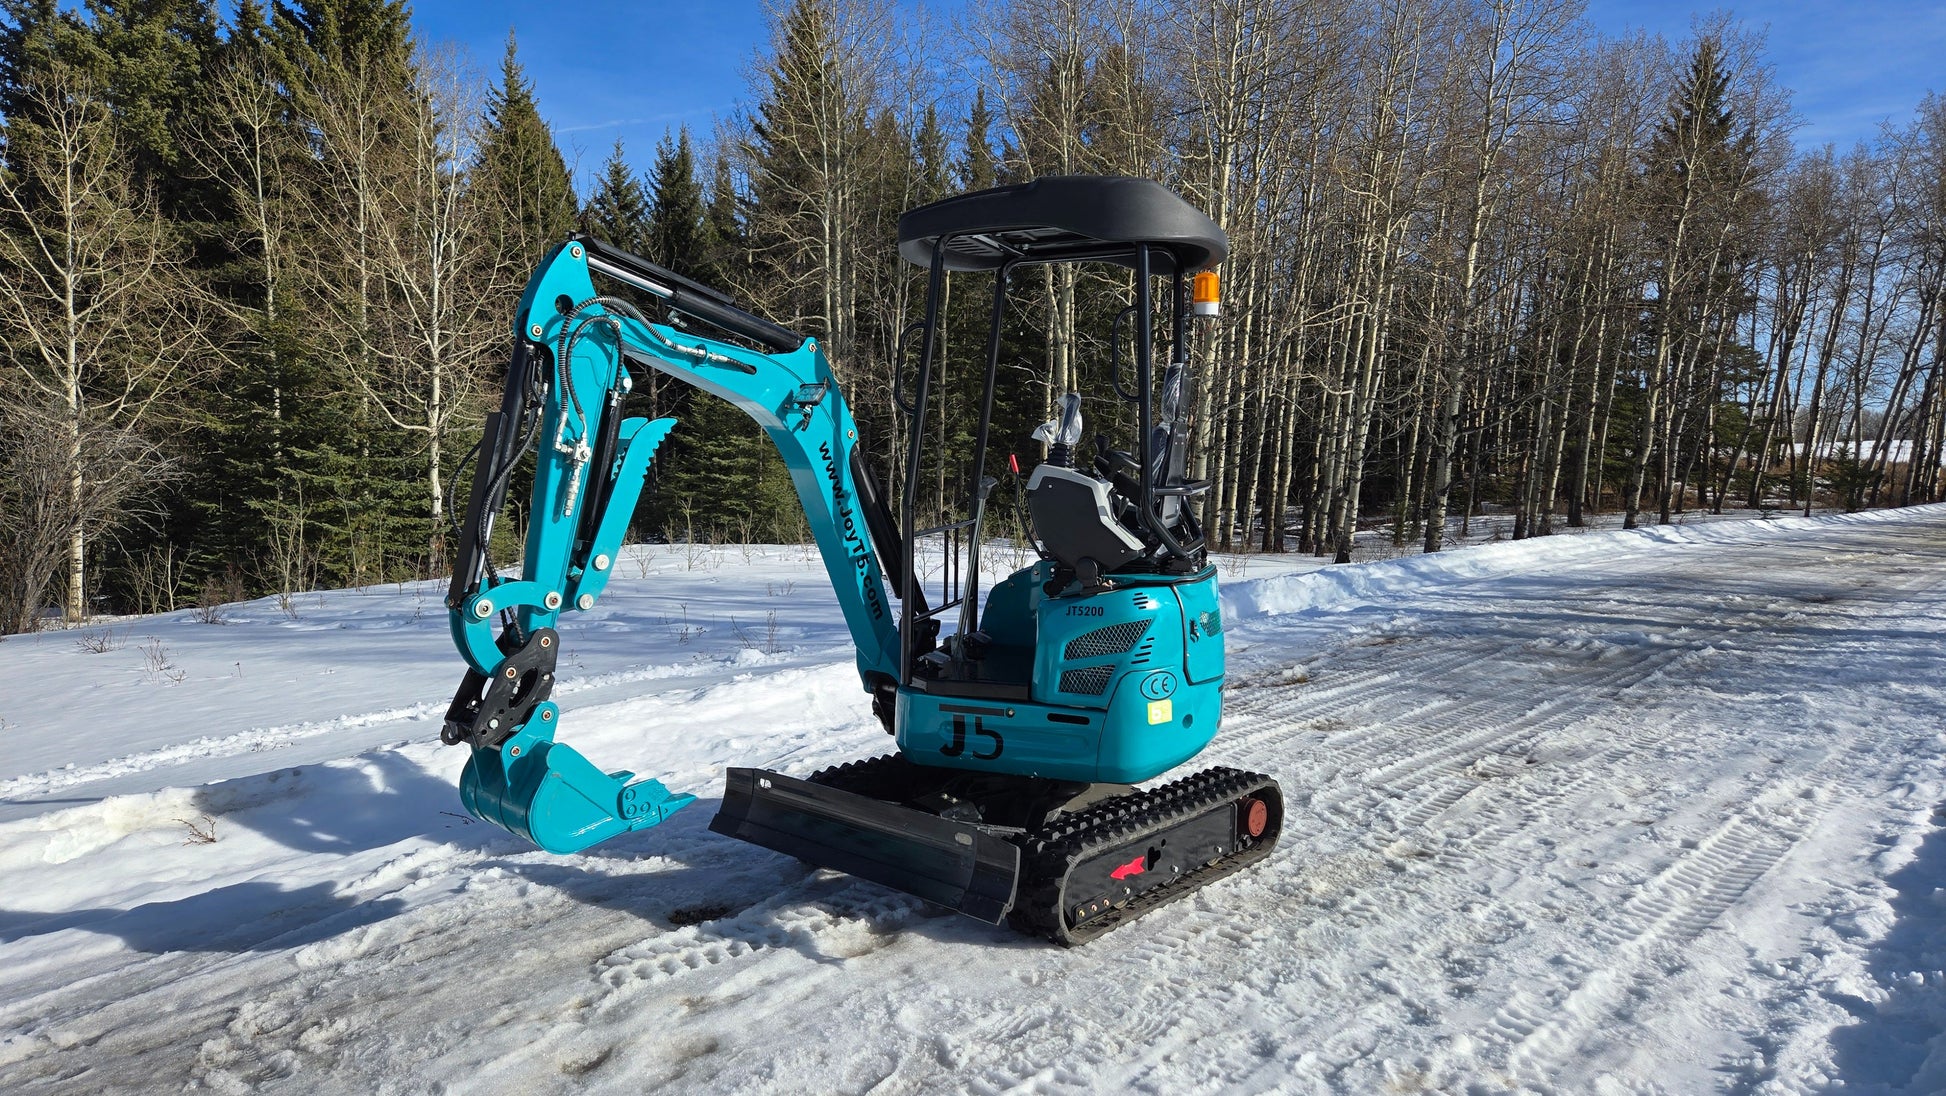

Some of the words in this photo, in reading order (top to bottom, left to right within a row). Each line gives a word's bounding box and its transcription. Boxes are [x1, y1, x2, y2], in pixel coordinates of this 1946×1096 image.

[819, 440, 883, 620] www.JoyT5.com
[1066, 606, 1104, 617] JT5200
[1151, 676, 1169, 695] CE
[939, 703, 1004, 760] J5
